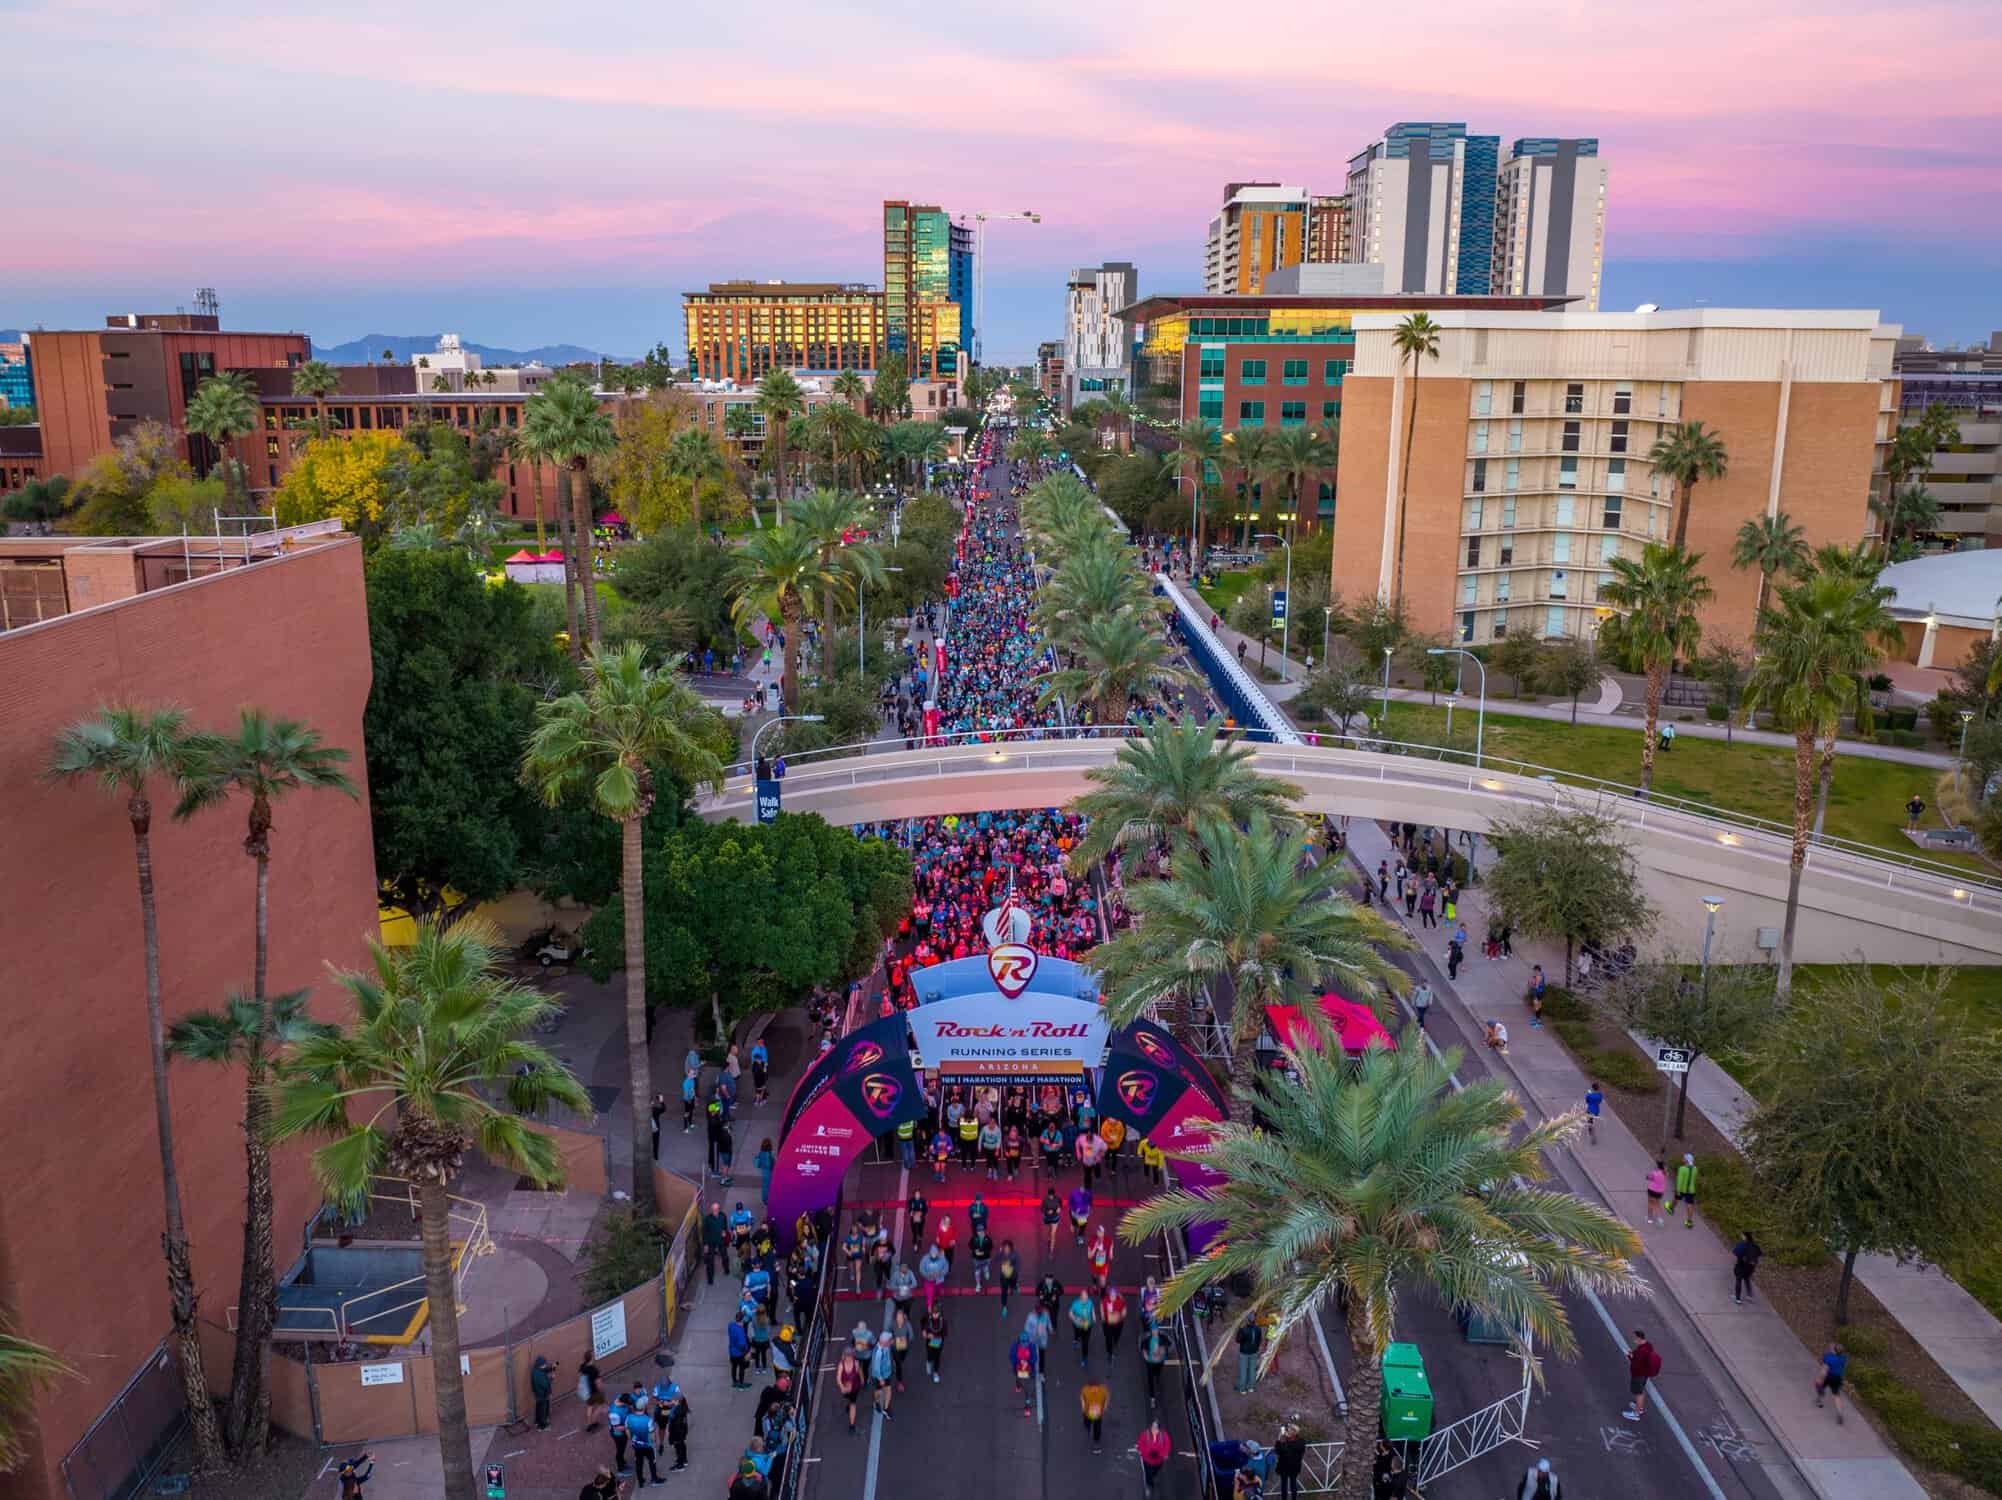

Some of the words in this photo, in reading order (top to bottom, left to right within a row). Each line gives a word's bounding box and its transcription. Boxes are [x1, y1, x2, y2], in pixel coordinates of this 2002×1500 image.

[759, 797, 778, 807] Walk
[761, 808, 778, 818] Safe
[950, 1048, 1017, 1056] RUNNING
[1020, 1048, 1073, 1056] SERIES
[978, 1063, 1039, 1071] ARIZONA
